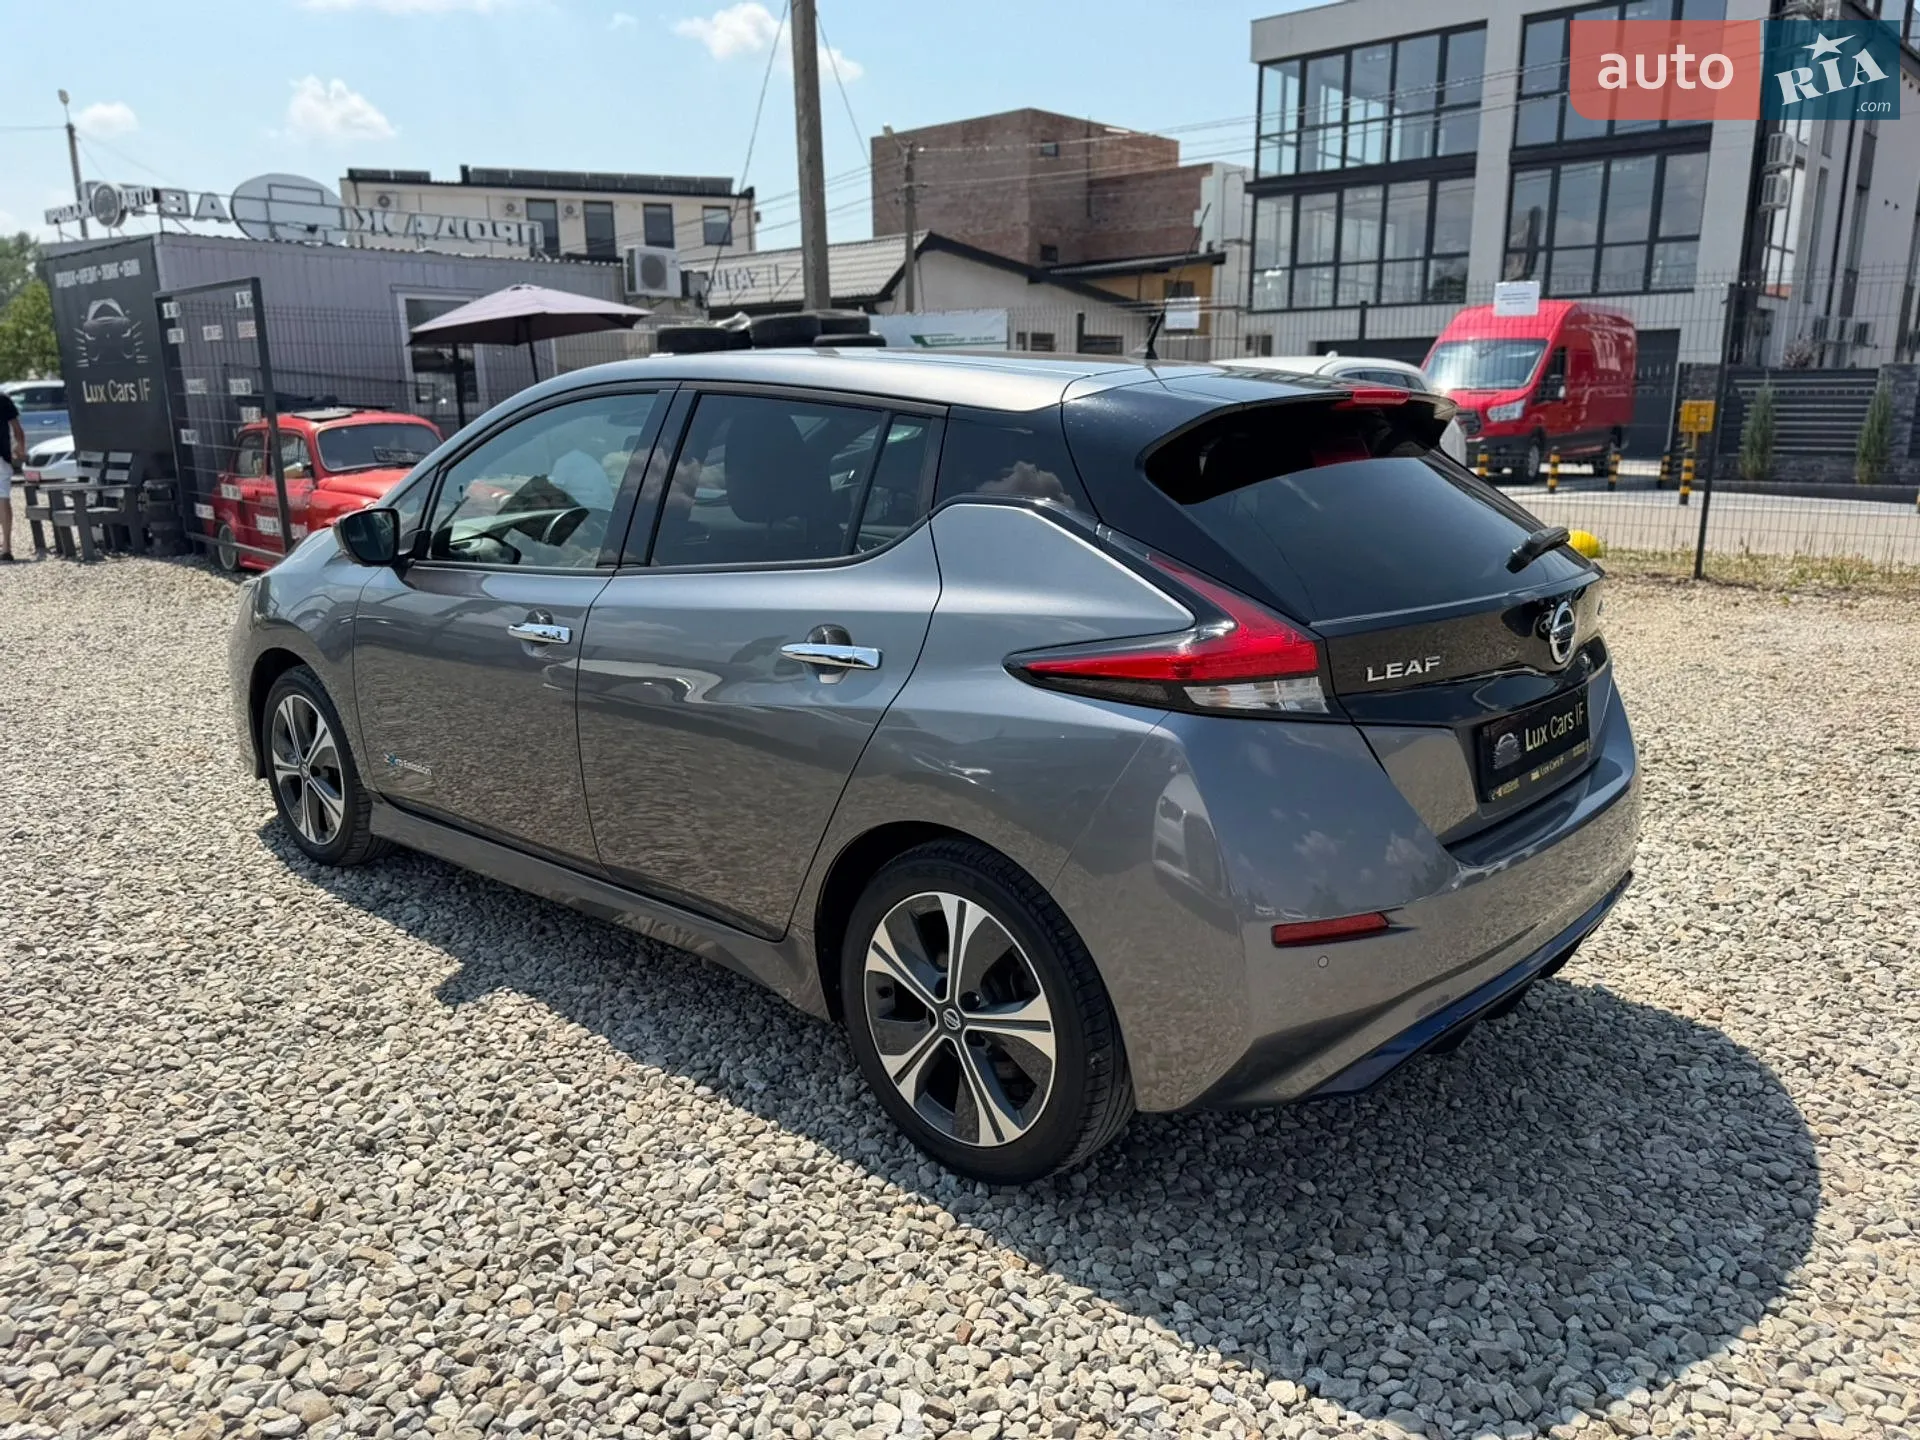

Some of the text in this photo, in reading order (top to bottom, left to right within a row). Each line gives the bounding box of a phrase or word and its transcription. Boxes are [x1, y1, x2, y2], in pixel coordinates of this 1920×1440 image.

[82, 377, 151, 403] Lux Cars IF
[1366, 656, 1440, 682] LEAF
[1525, 725, 1548, 751] Lux
[1550, 715, 1575, 738] Cars
[1575, 702, 1585, 726] IF
